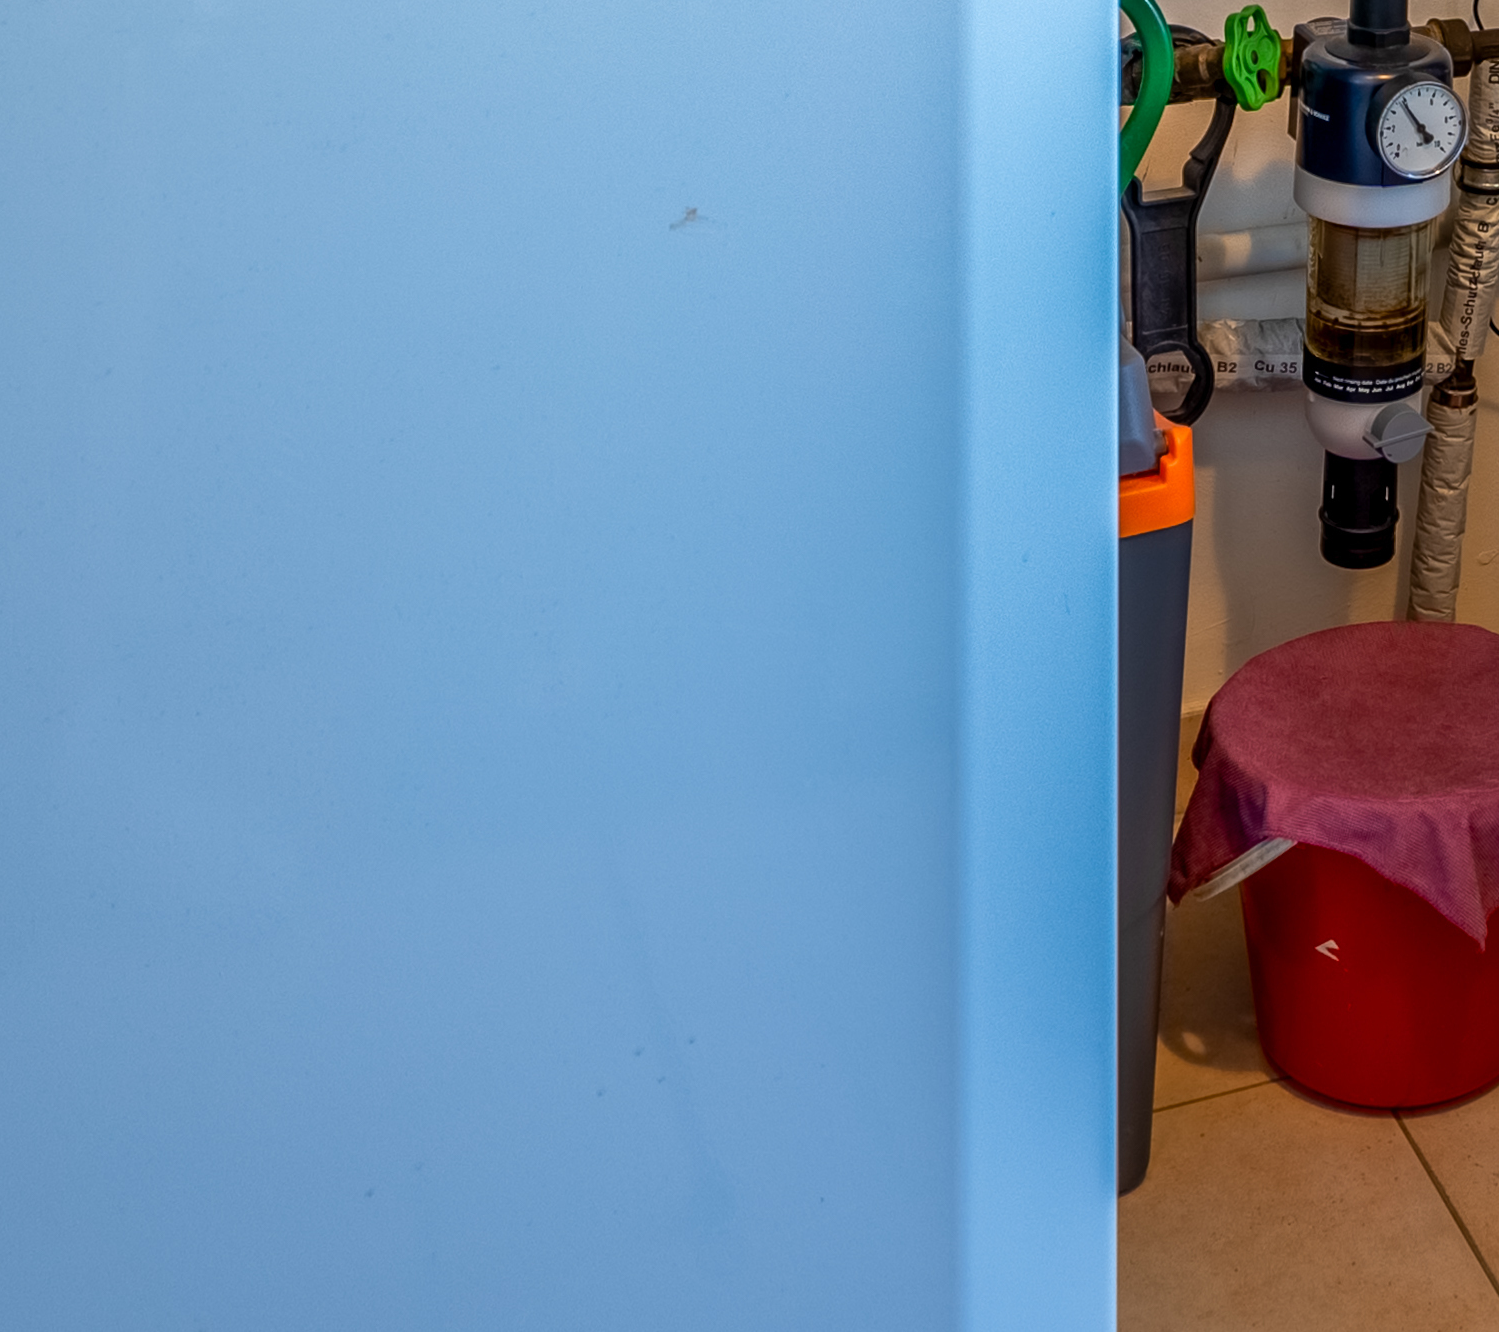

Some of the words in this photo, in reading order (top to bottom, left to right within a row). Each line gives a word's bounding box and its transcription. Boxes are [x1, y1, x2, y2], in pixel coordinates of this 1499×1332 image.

[1217, 361, 1238, 373] B2
[1254, 360, 1275, 373] Cu
[1279, 362, 1298, 374] 35
